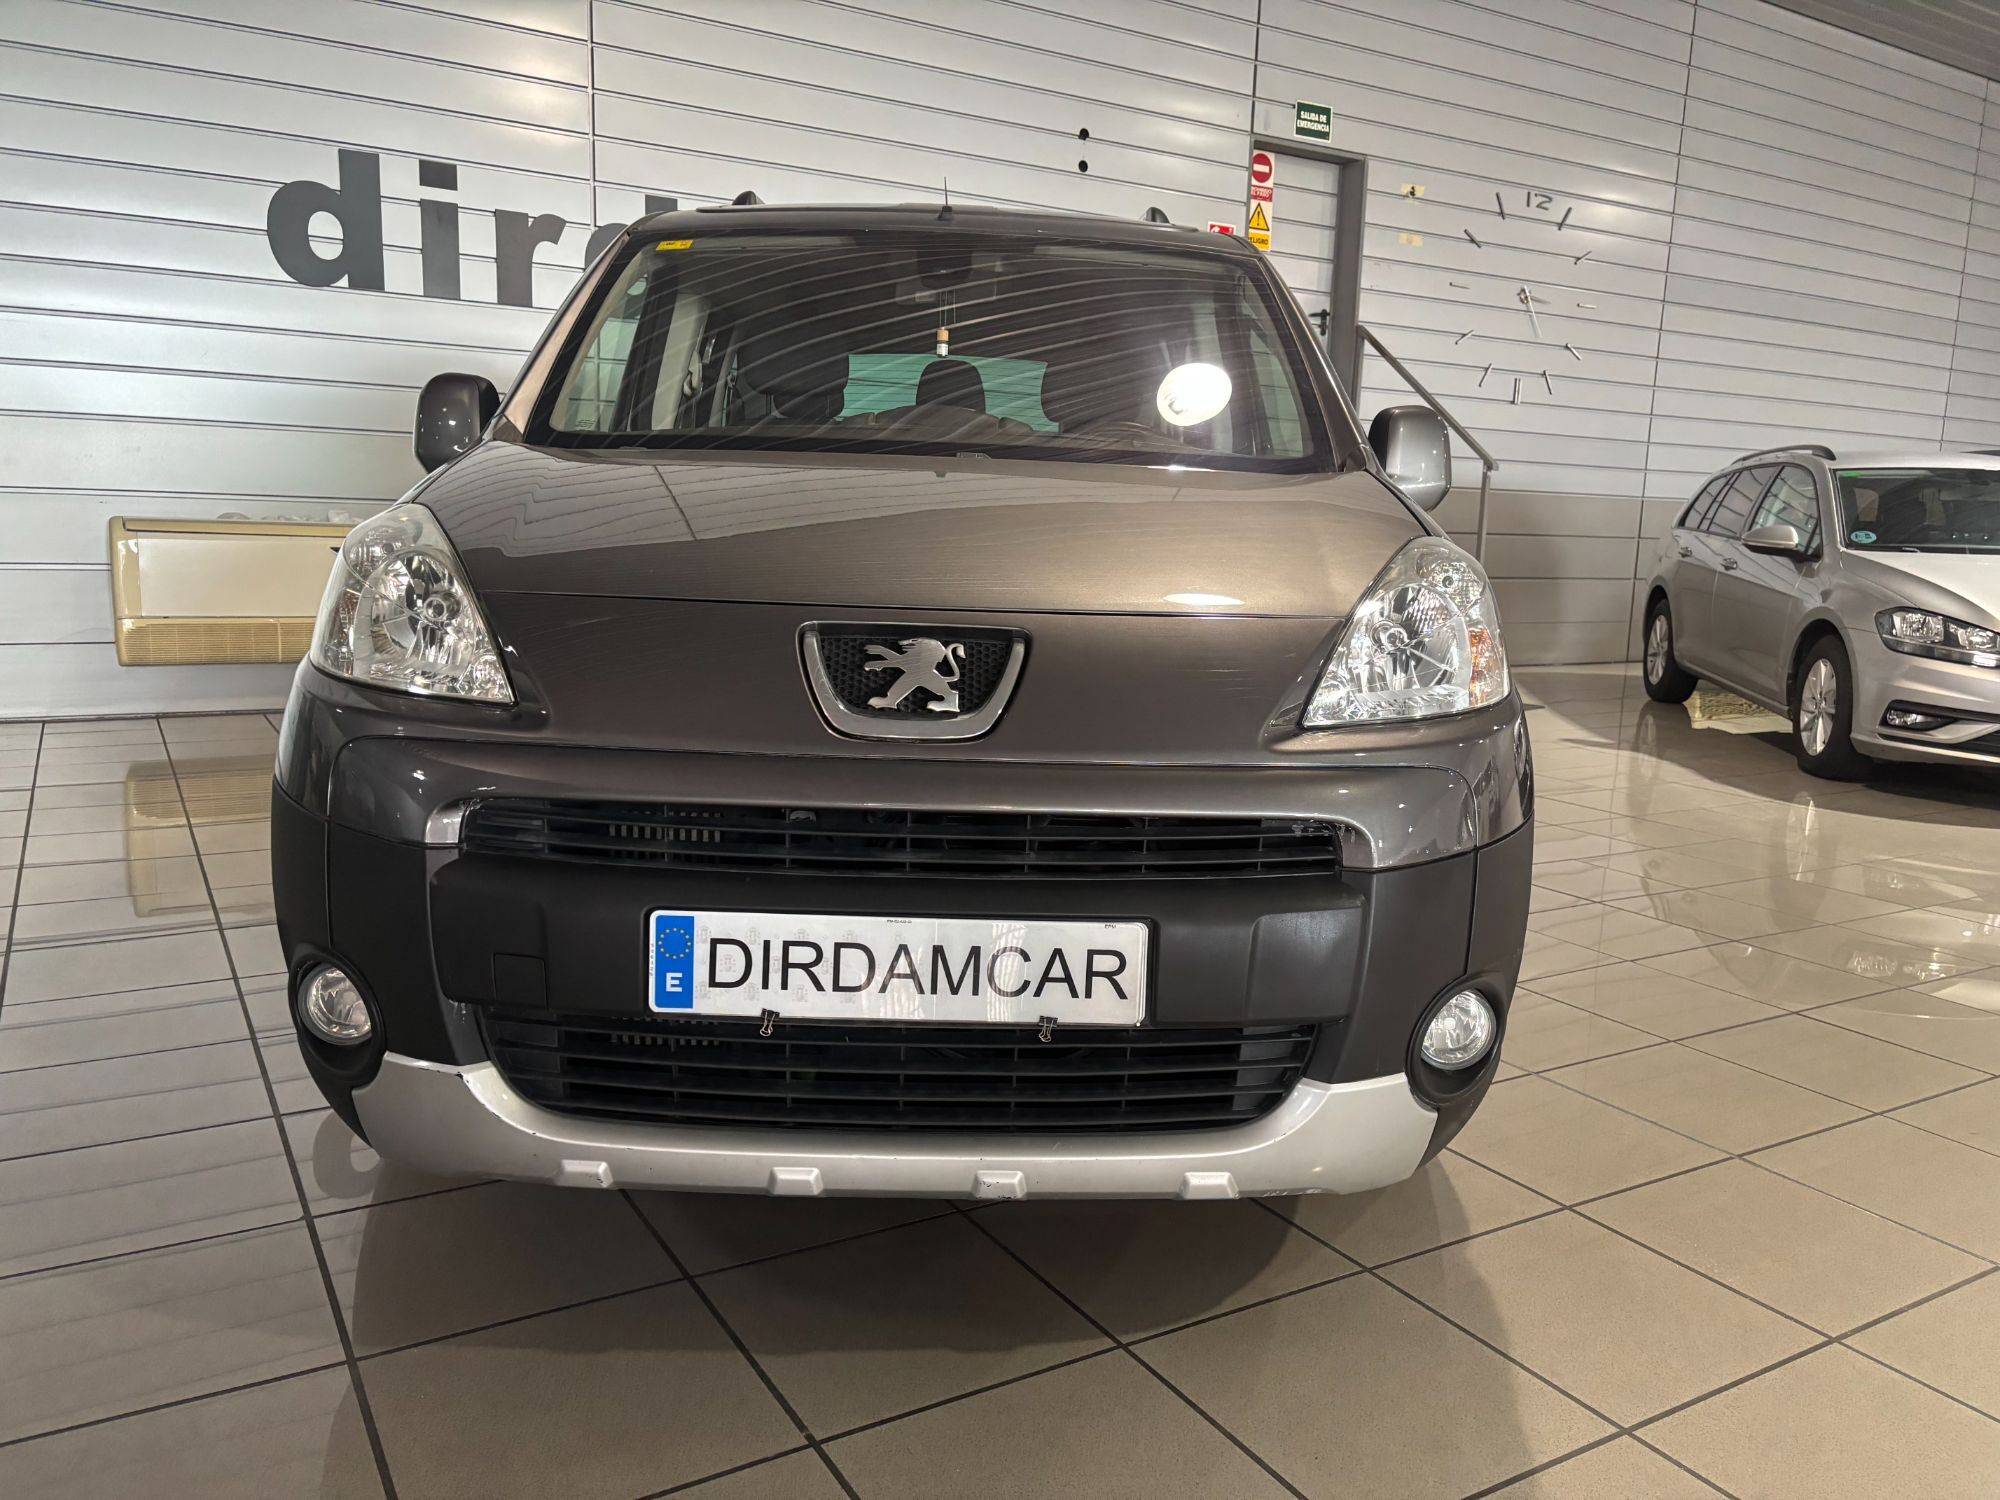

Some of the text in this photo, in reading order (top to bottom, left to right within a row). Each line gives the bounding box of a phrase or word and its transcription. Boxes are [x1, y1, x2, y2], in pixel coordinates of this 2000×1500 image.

[1297, 119, 1330, 132] EMERGENCIA
[1300, 110, 1328, 123] SALIDA DE
[1526, 191, 1552, 211] 12
[707, 937, 1129, 1000] DIRDAMCAR
[666, 972, 683, 992] E
